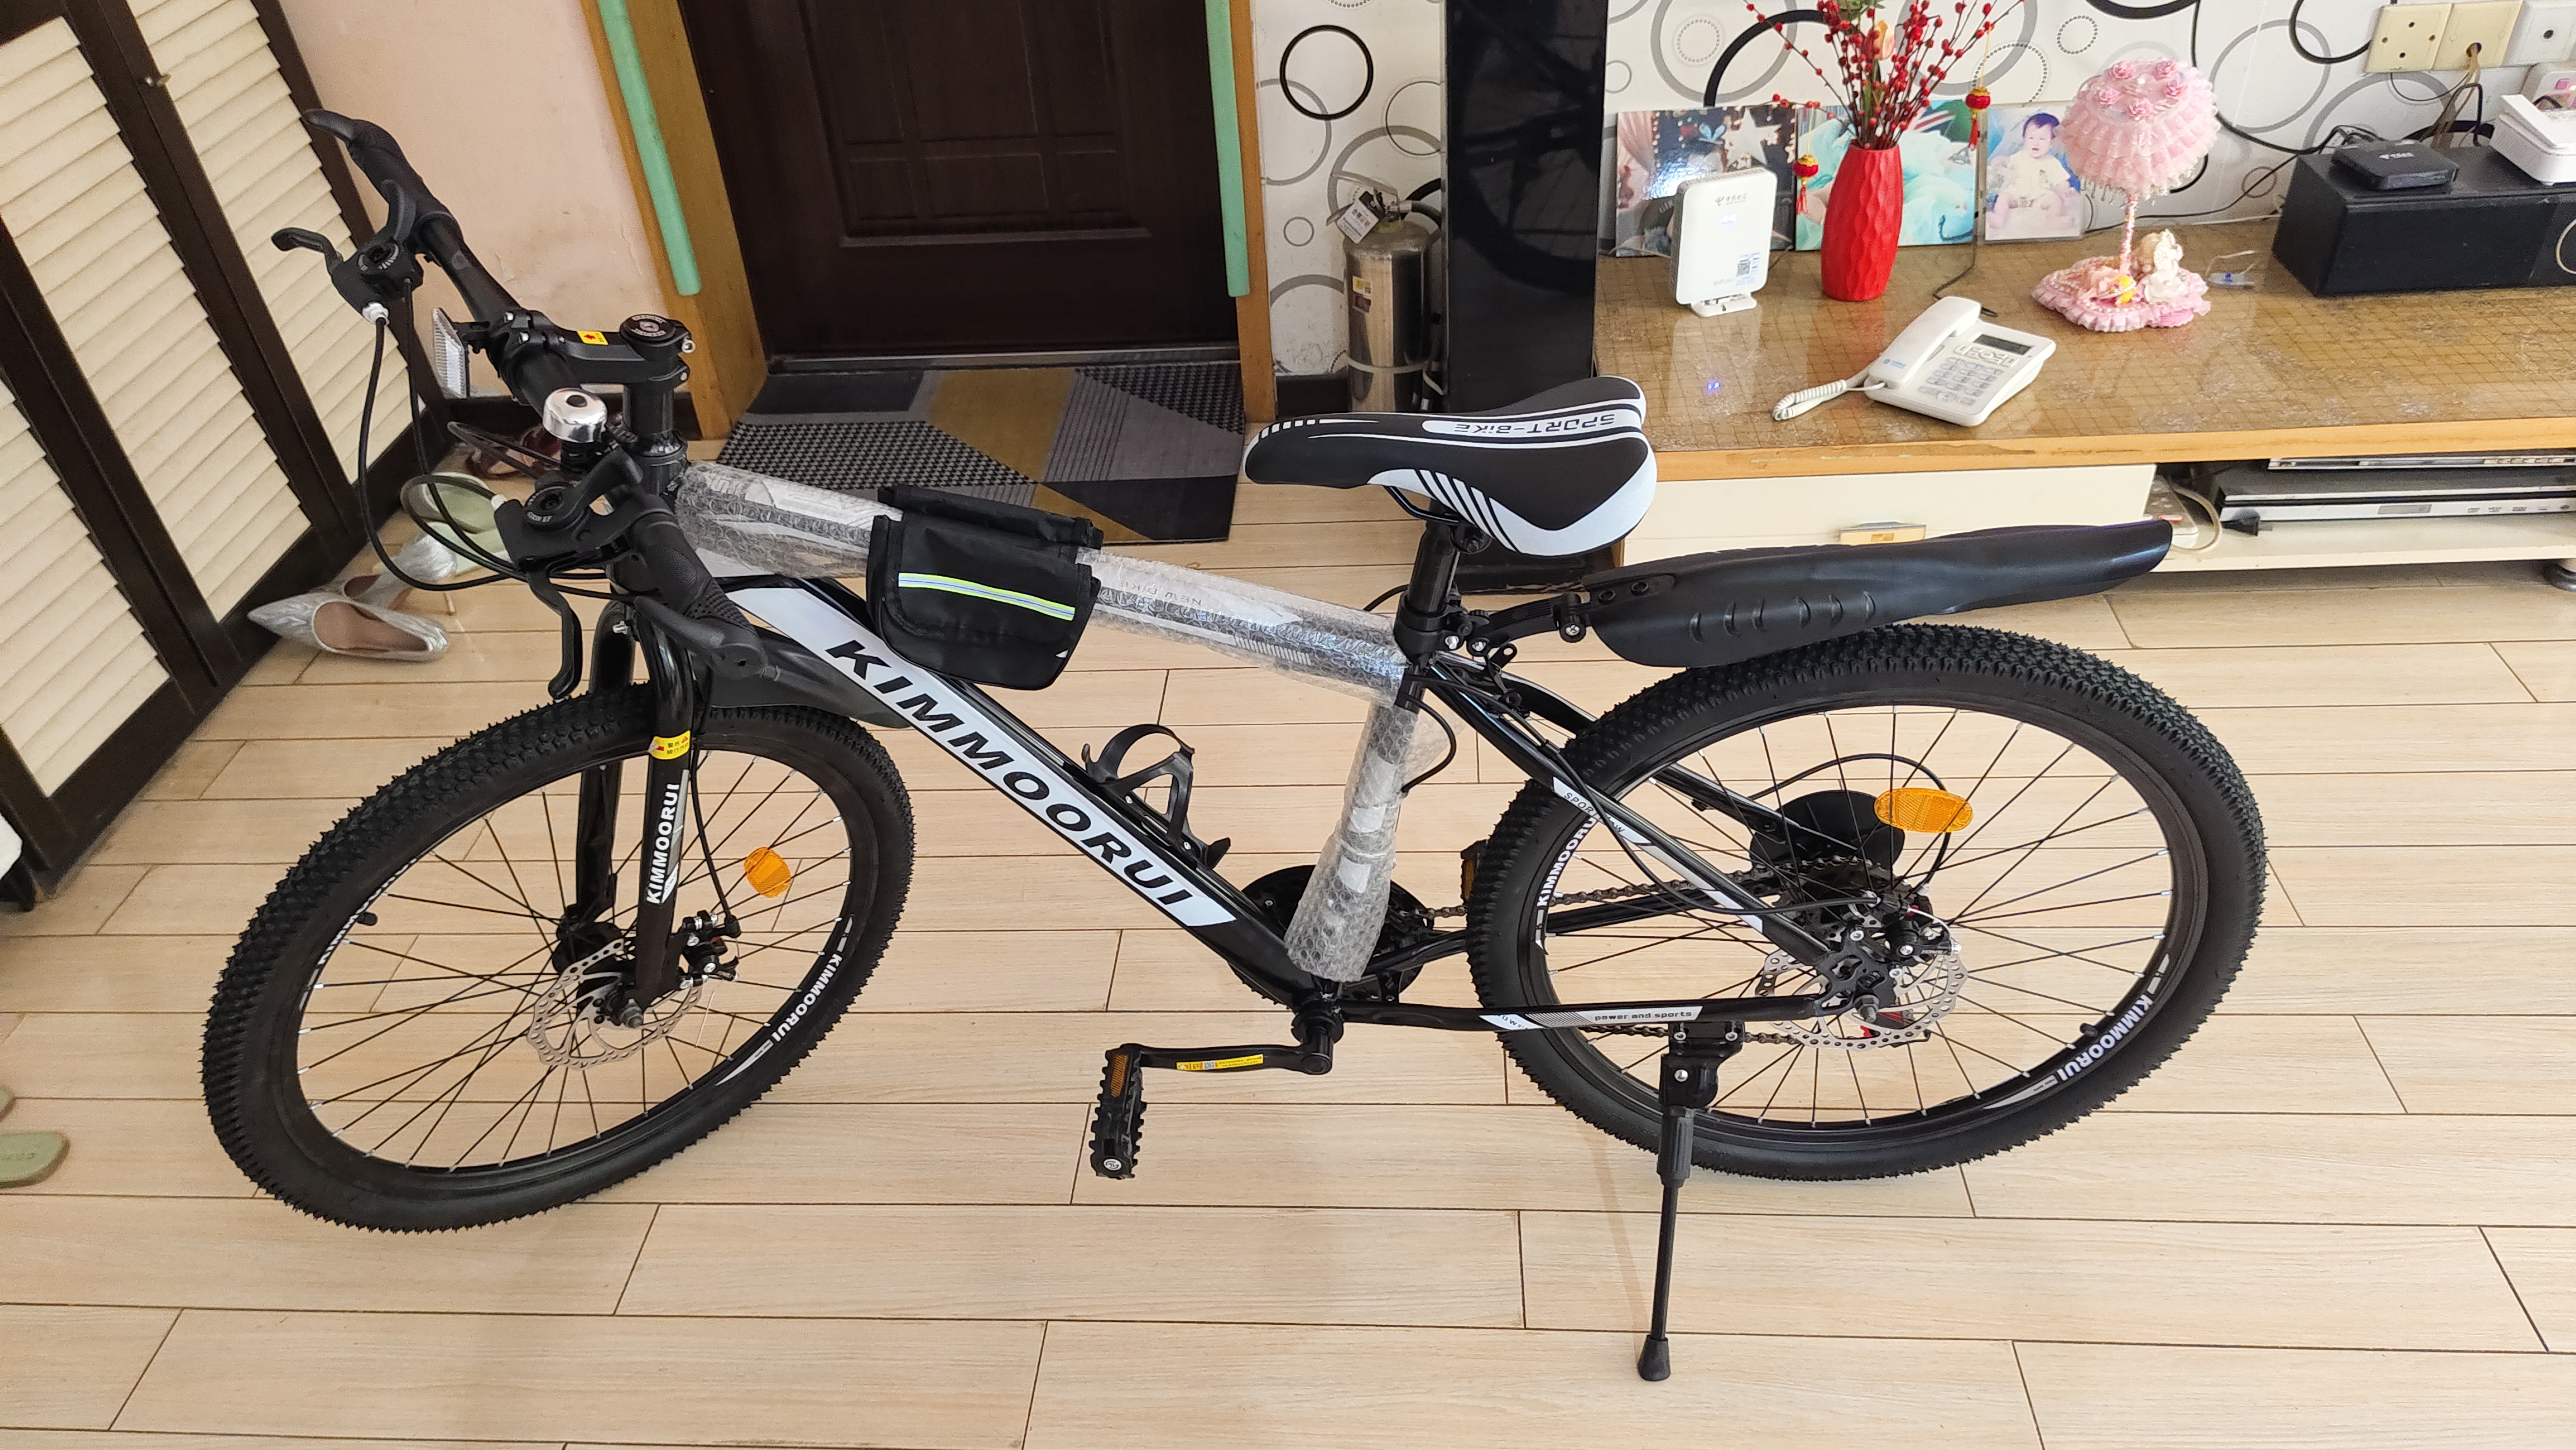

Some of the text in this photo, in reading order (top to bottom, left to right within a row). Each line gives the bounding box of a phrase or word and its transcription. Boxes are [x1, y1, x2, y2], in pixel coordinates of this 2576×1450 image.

[825, 638, 1193, 905] KIMMOORUI
[646, 784, 679, 904] KIMMOORUI
[1537, 818, 1597, 908] KIMMOORU
[772, 953, 842, 1041] KIMMOORUI
[2058, 993, 2154, 1082] KIMMOORUI
